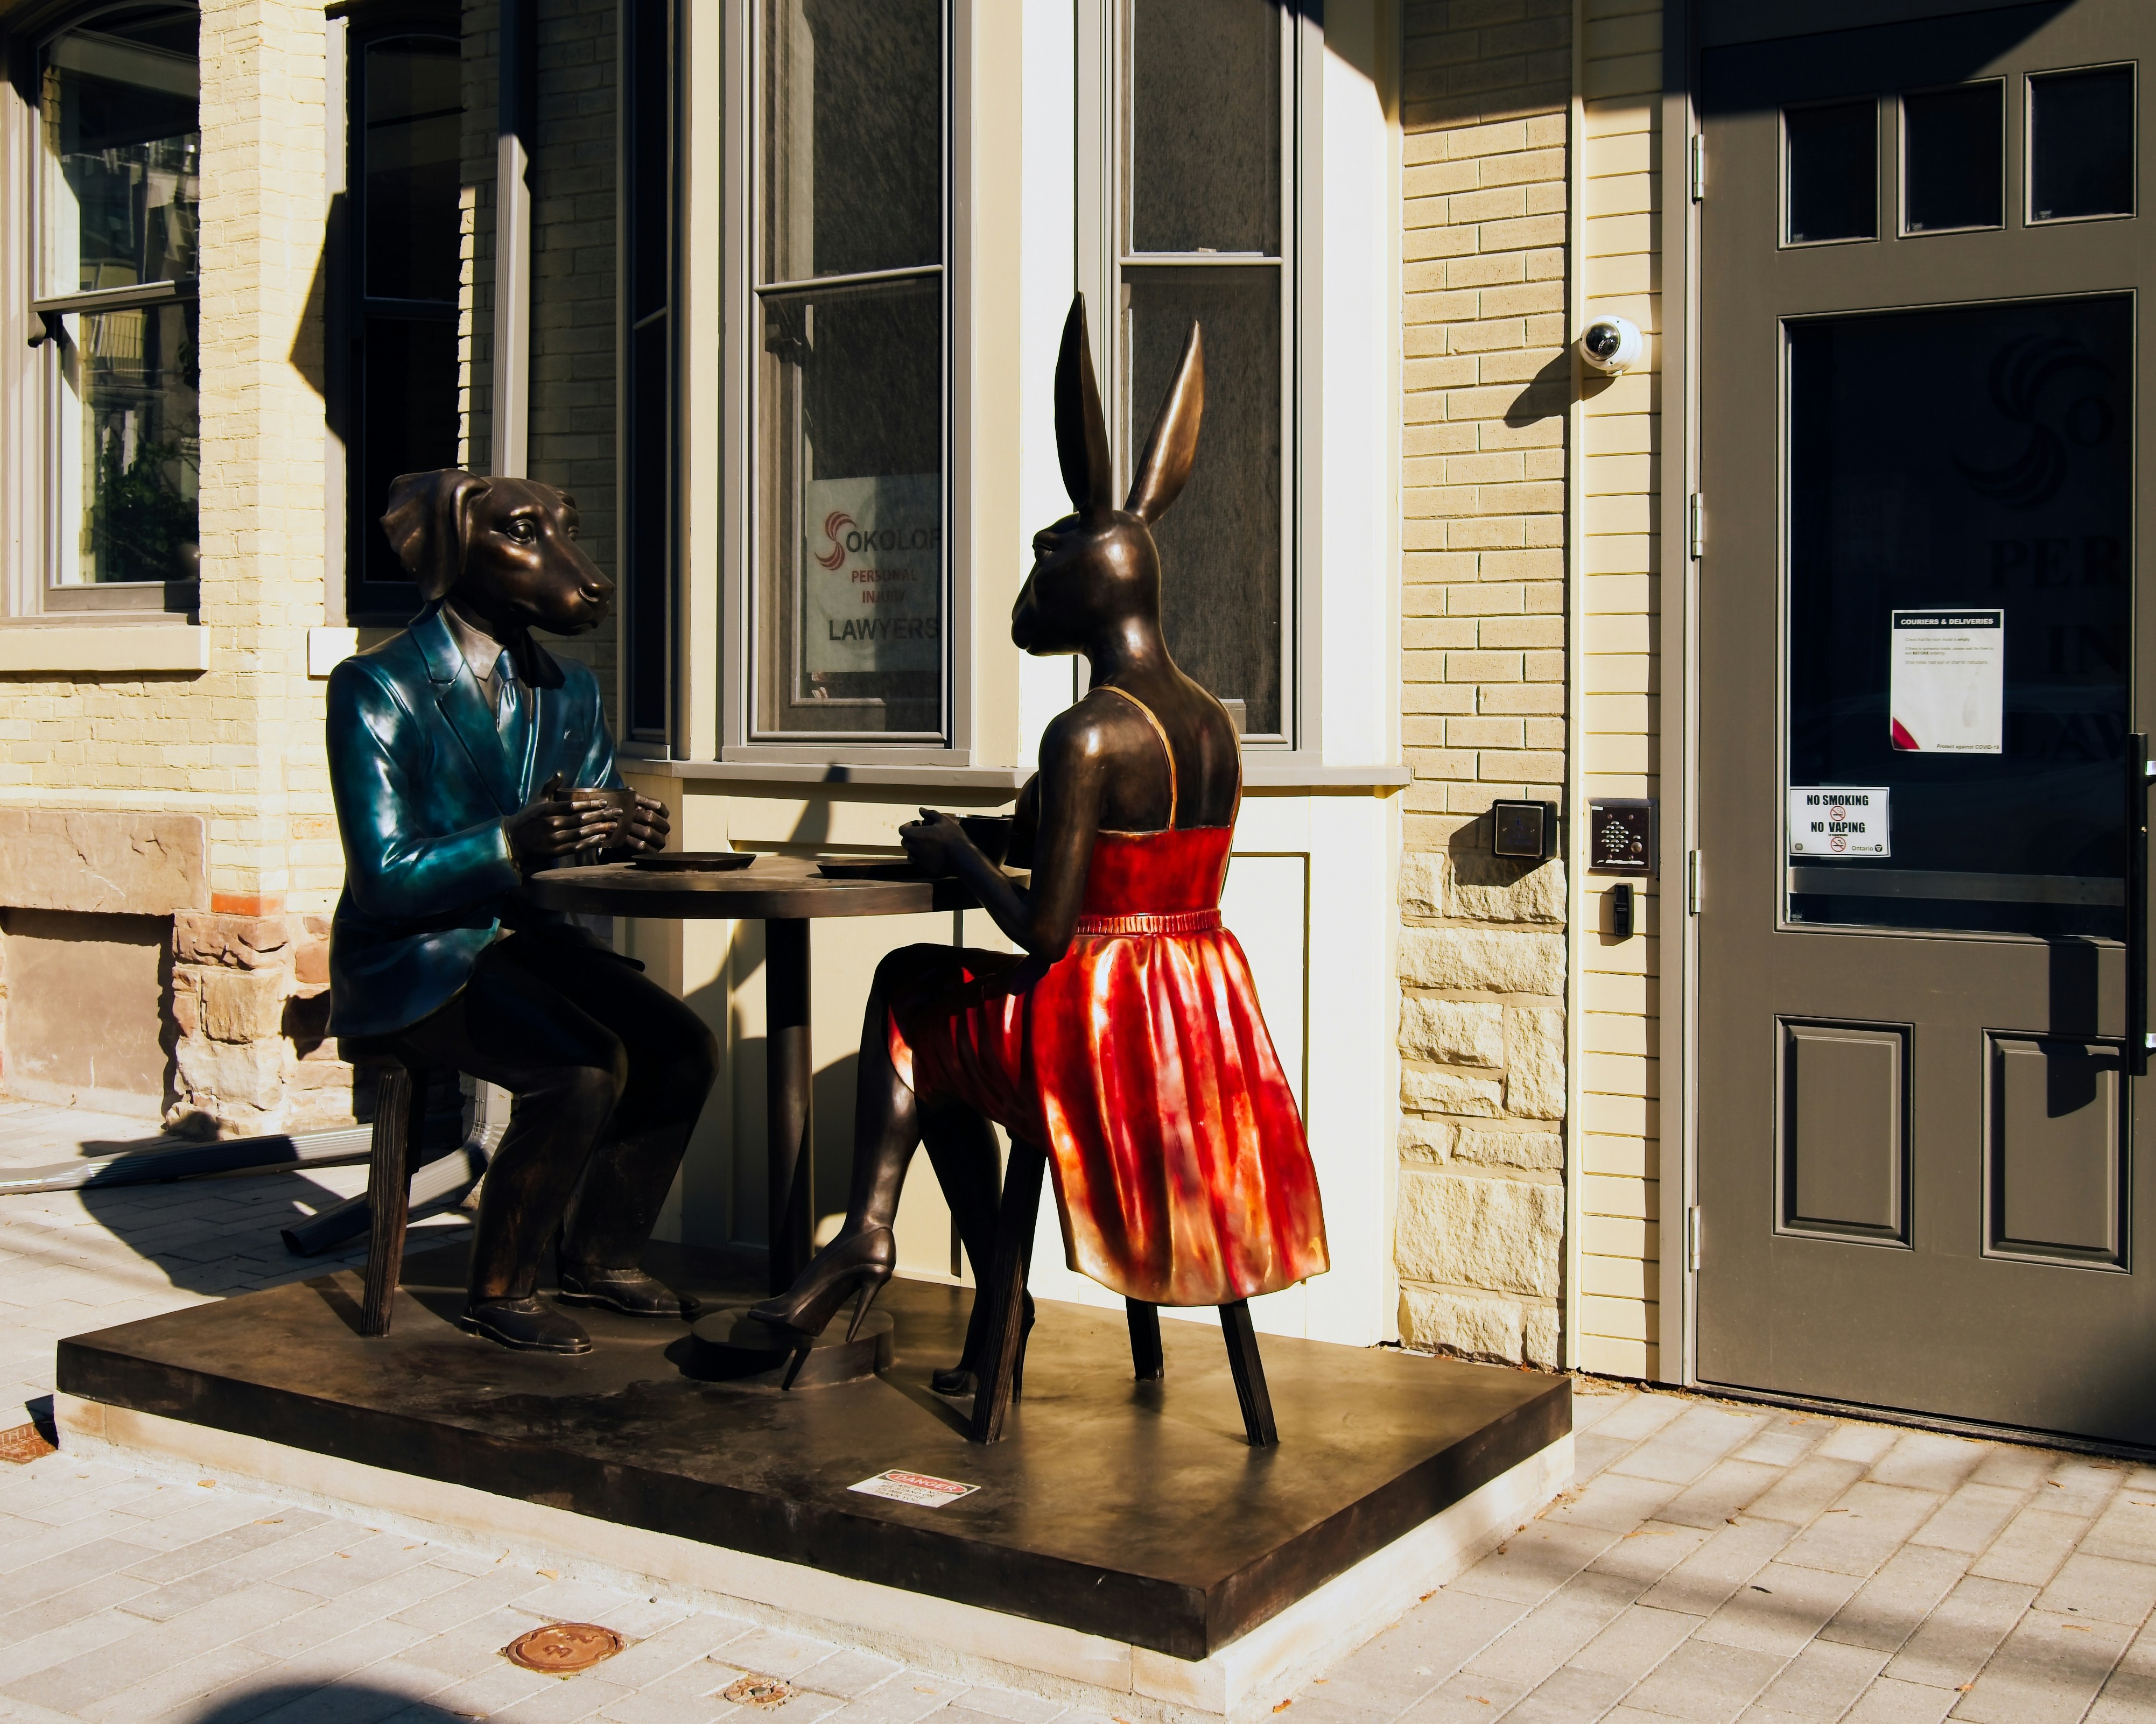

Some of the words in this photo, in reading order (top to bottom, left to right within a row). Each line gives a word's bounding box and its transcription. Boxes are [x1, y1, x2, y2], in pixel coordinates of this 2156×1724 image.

[852, 569, 917, 582] PERSONAL
[862, 589, 907, 603] INJURY
[829, 617, 940, 641] LAWYERS
[1807, 794, 1820, 805] NO
[1822, 794, 1869, 806] SMOKING
[1811, 821, 1824, 832] NO
[1829, 822, 1865, 833] VAPING
[882, 1481, 912, 1489] PLEASE
[894, 1475, 957, 1491] DANGER
